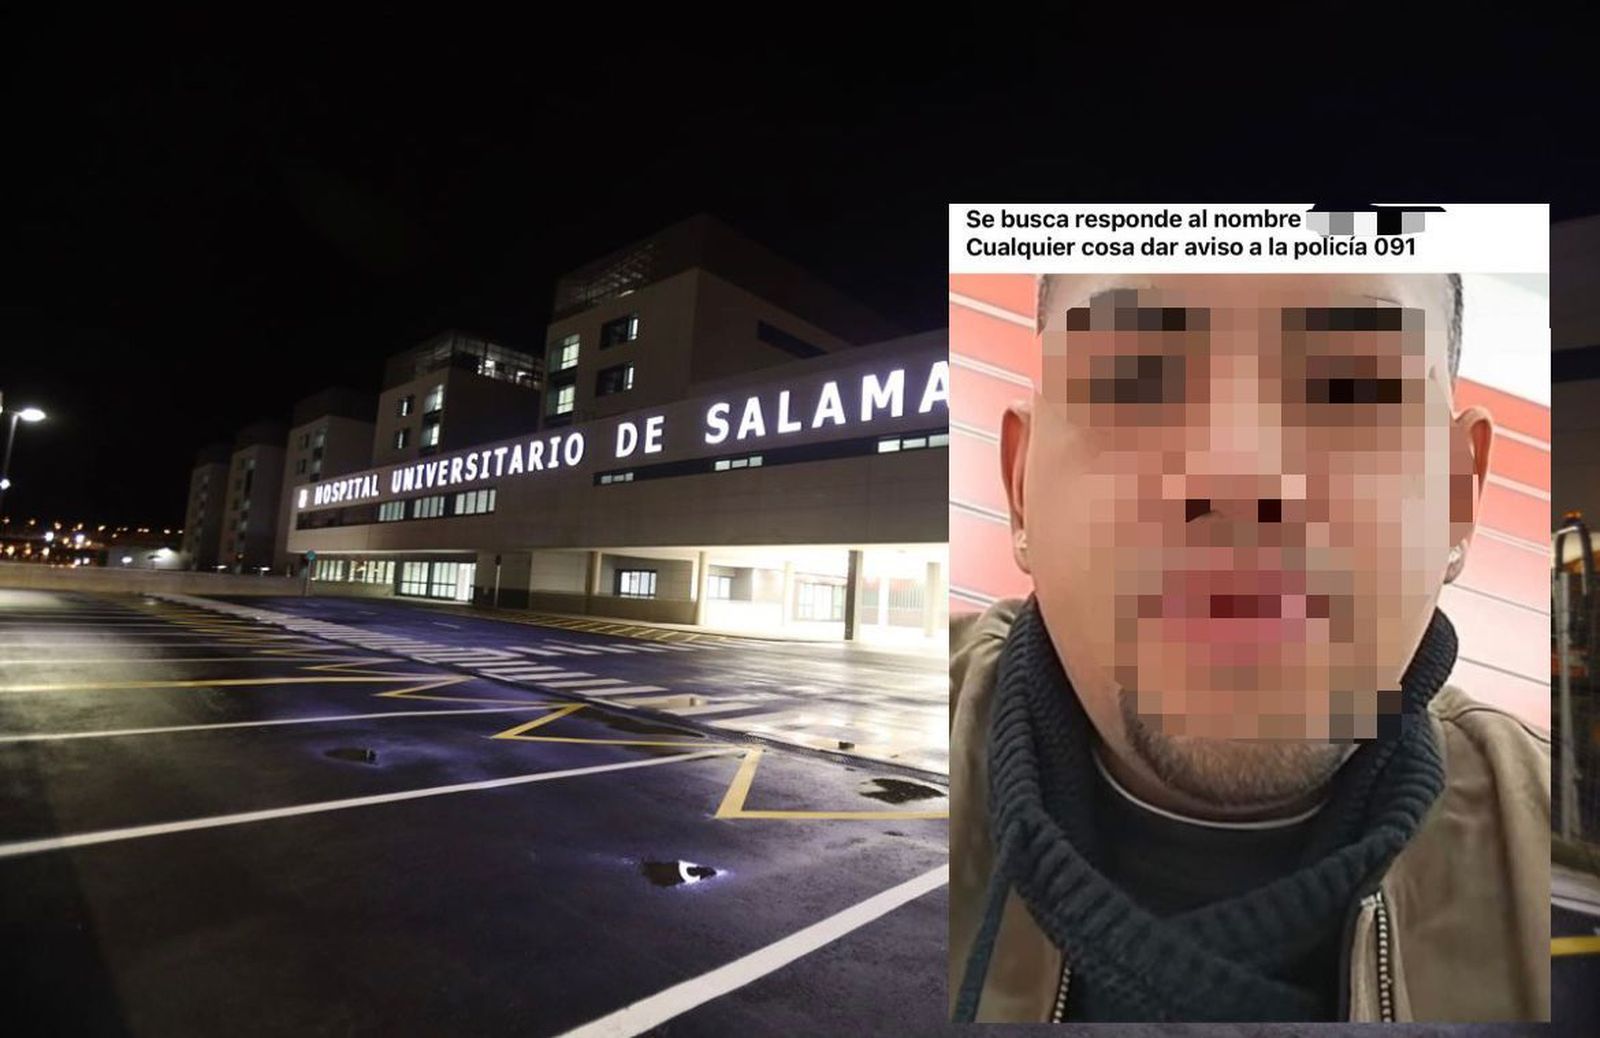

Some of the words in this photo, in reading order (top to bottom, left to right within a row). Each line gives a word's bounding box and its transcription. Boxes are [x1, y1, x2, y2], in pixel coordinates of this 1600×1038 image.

[313, 474, 379, 506] HOSPITAL
[391, 432, 584, 494] UNIVERSITARIO
[615, 415, 665, 458] DE
[704, 360, 950, 445] SALAMA
